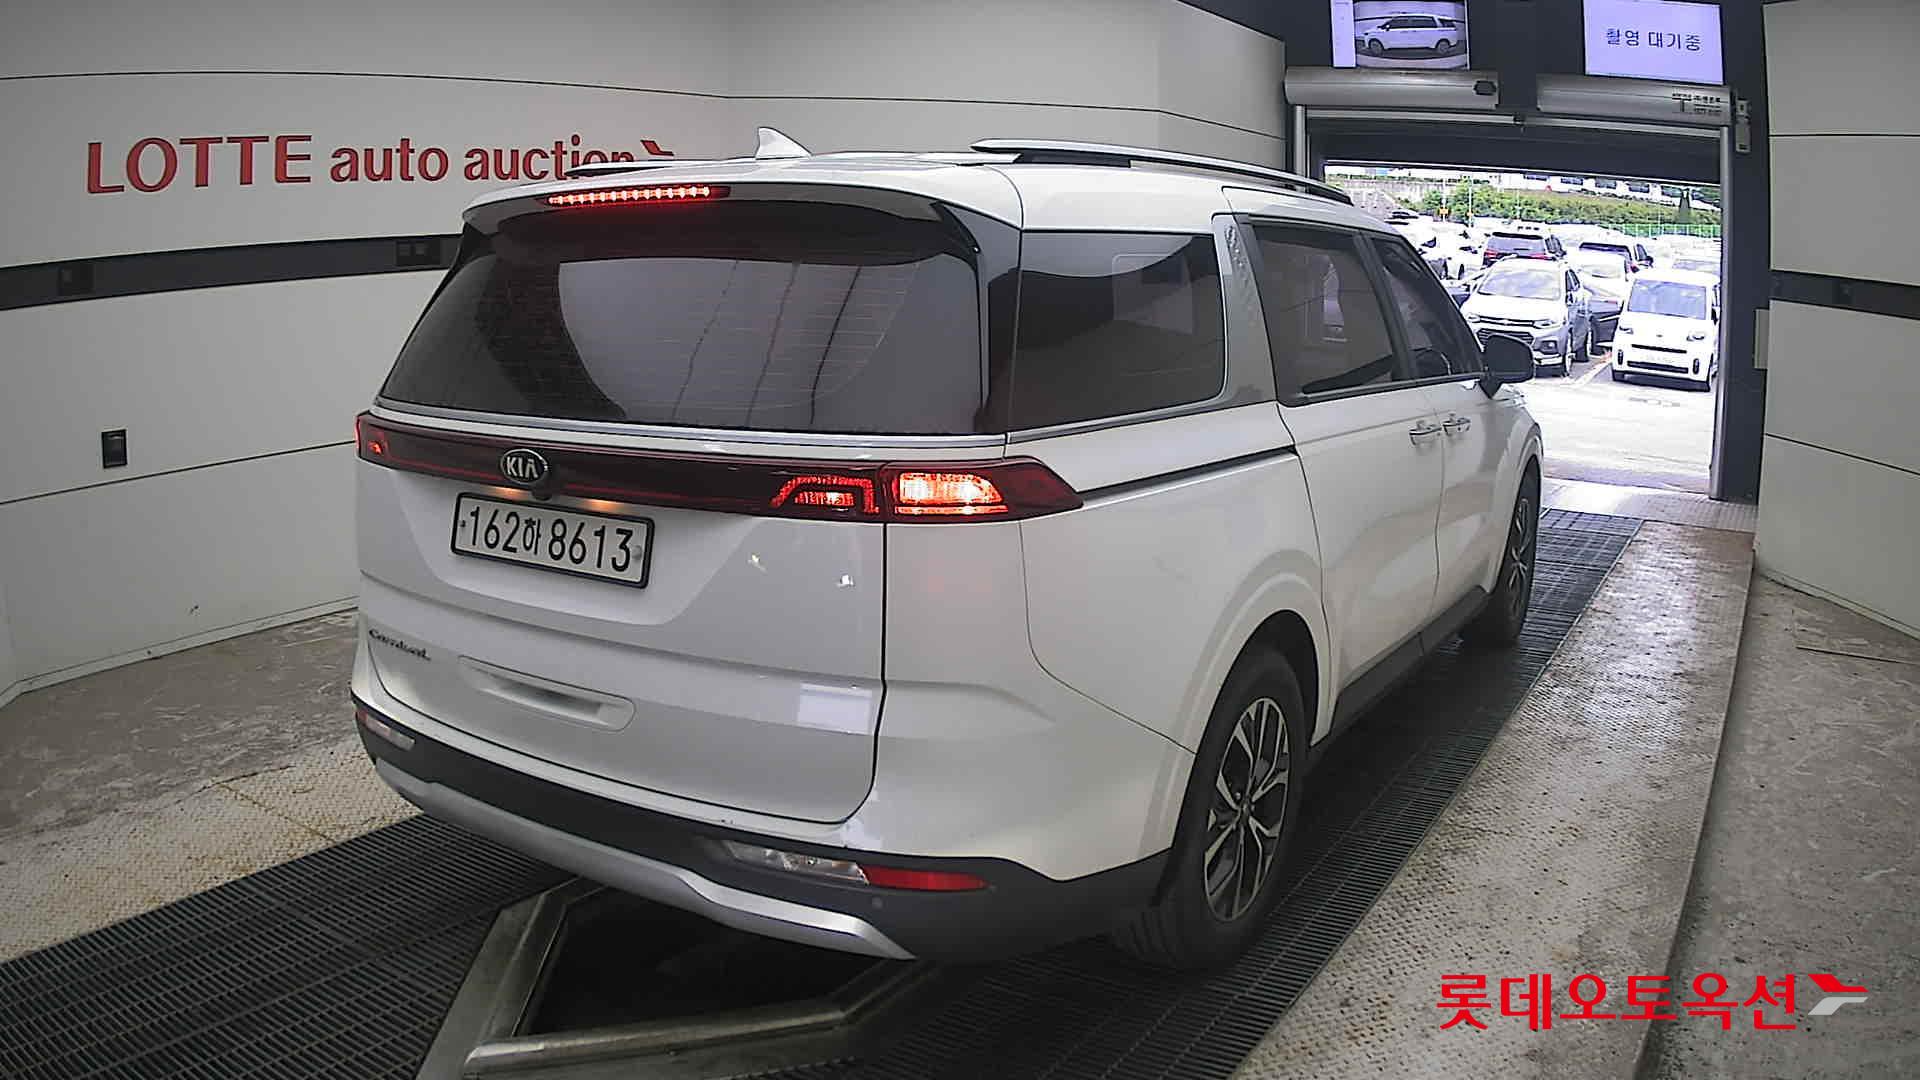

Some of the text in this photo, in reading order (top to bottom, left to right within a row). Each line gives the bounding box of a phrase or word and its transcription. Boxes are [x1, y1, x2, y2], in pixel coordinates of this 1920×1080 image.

[1606, 28, 1701, 52] 촬영 대기중
[87, 134, 313, 194] LOTTE
[329, 137, 450, 182] auto
[506, 455, 539, 479] KIA
[548, 517, 635, 573] 8613
